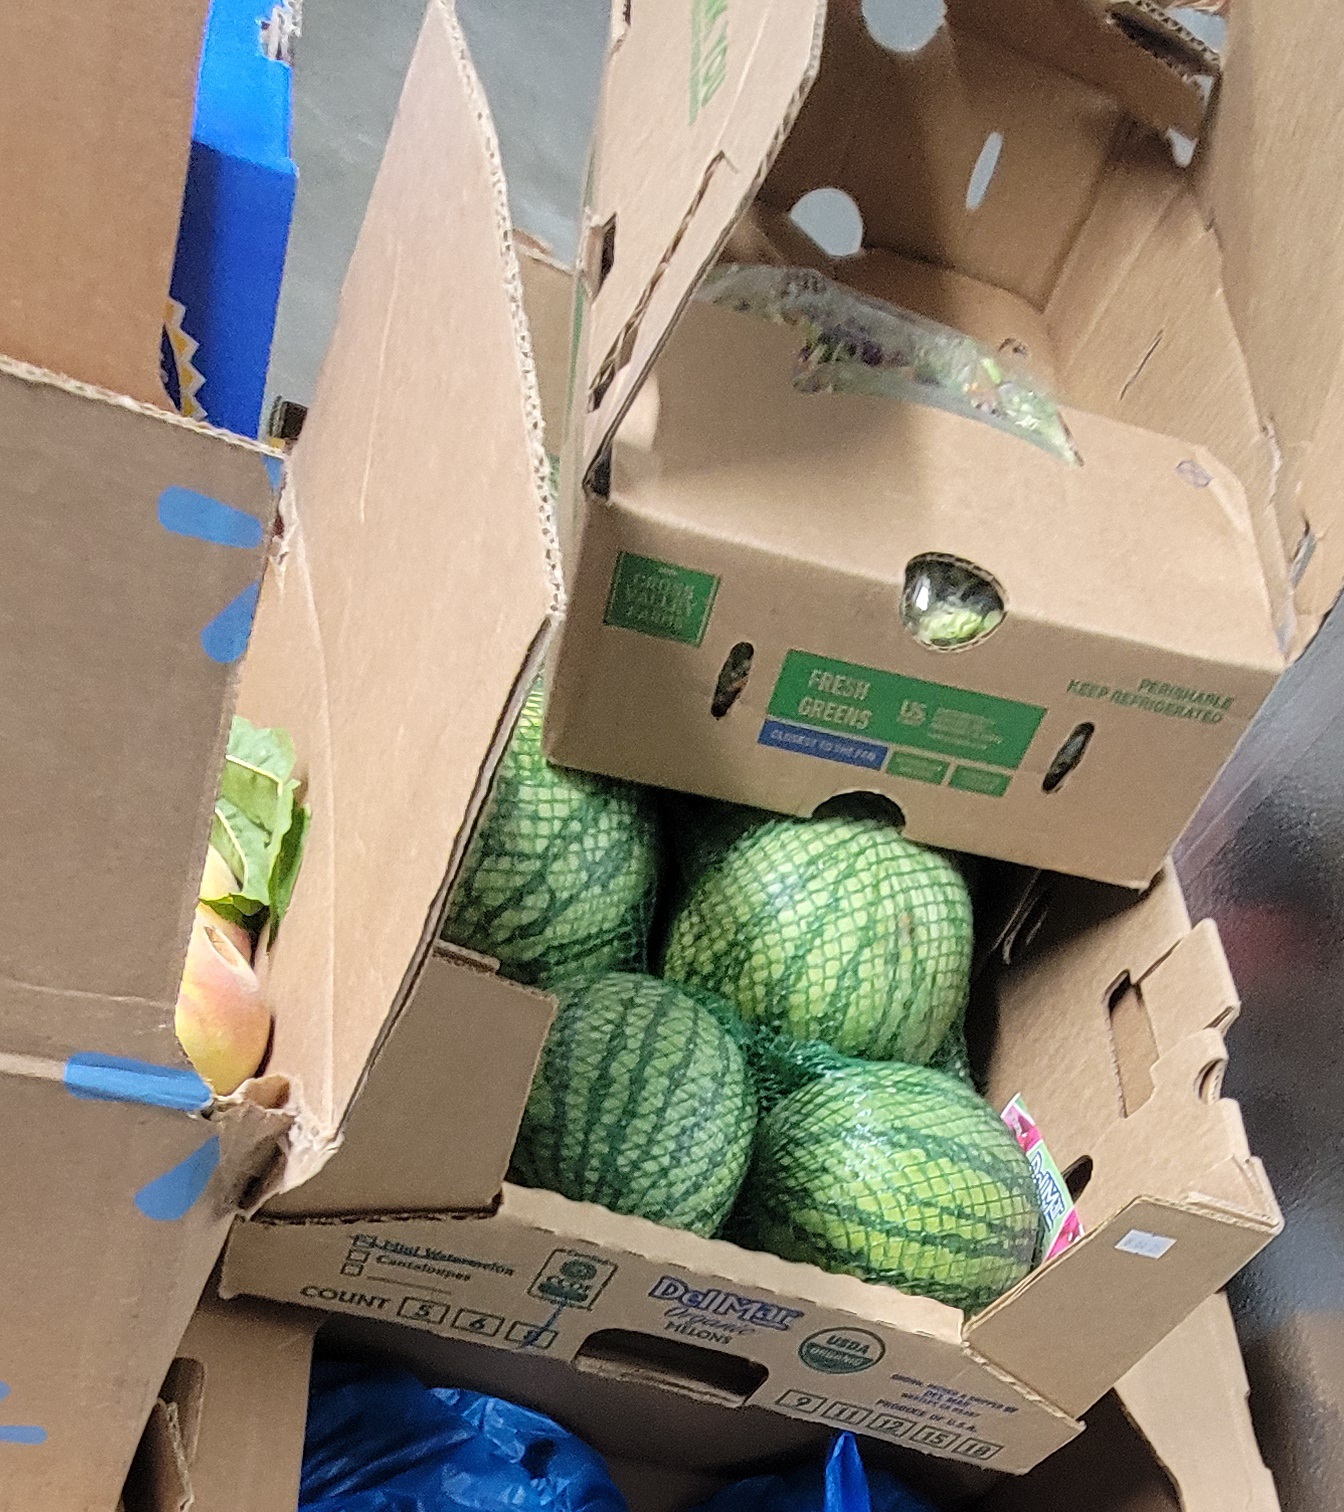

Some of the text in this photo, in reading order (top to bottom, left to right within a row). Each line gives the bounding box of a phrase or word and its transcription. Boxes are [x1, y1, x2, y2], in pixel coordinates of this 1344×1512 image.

[808, 669, 871, 701] FRESH
[798, 697, 873, 729] GREENS
[376, 1254, 471, 1282] Cantaloupes
[299, 1285, 394, 1310] COUNT
[664, 1321, 732, 1344] MELONS
[826, 1334, 870, 1355] USDA
[795, 1396, 812, 1408] 9
[836, 1407, 857, 1420] 11
[881, 1420, 901, 1433] 12
[924, 1431, 946, 1445] 15
[875, 1399, 926, 1417] PRODUCE
